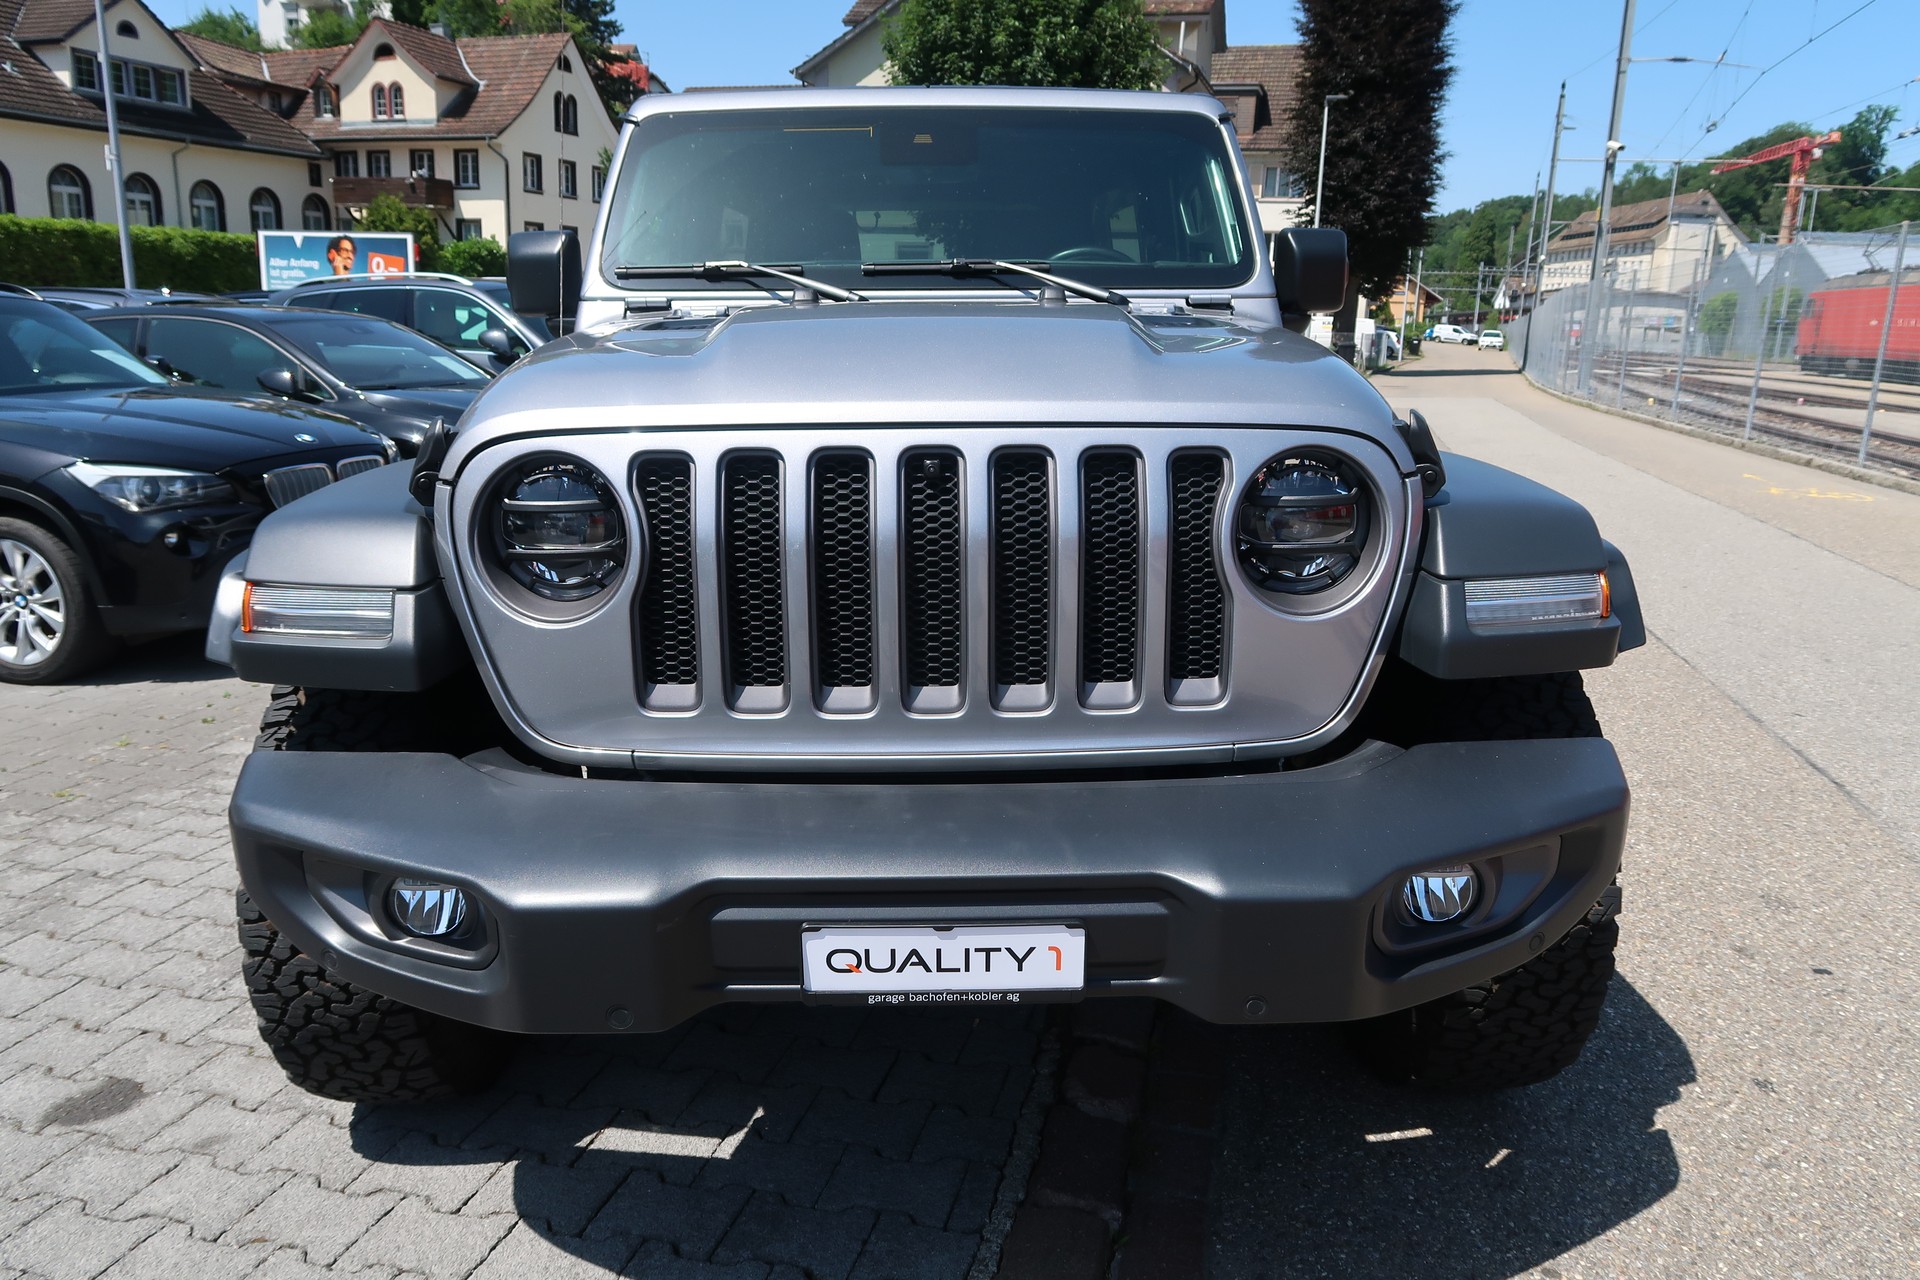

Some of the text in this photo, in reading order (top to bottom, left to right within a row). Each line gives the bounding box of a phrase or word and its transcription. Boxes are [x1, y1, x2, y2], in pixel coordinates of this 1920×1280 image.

[289, 257, 319, 270] Anfang
[825, 945, 1062, 974] QUALITY 1
[868, 992, 1020, 1004] garage bachofen+kobler ag
